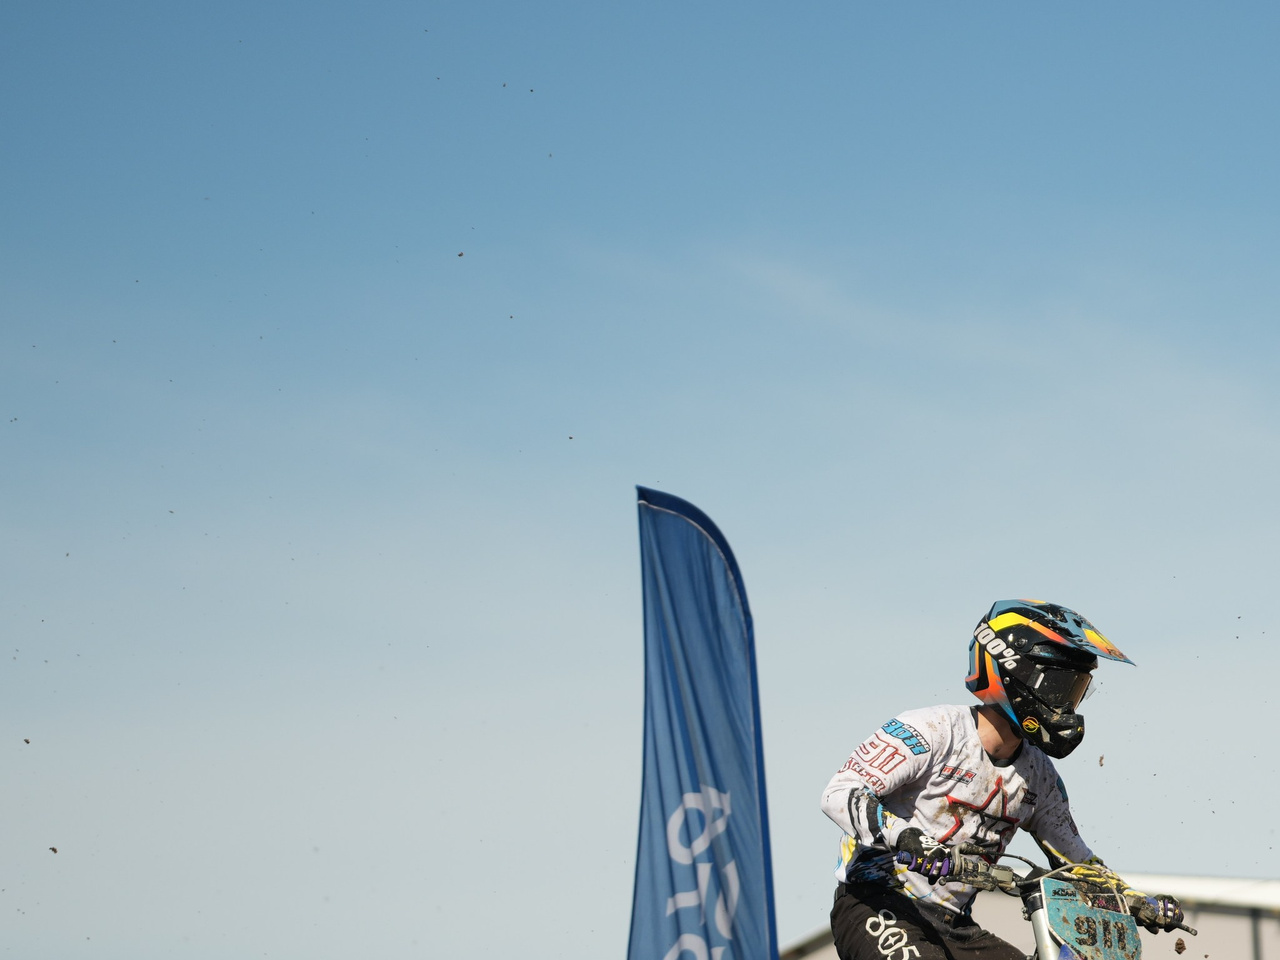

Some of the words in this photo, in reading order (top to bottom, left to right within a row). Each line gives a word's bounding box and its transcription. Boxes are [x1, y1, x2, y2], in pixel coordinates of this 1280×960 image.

[973, 622, 1021, 670] 100%
[854, 733, 907, 775] 911
[903, 723, 931, 752] RACING
[1074, 916, 1127, 951] 911
